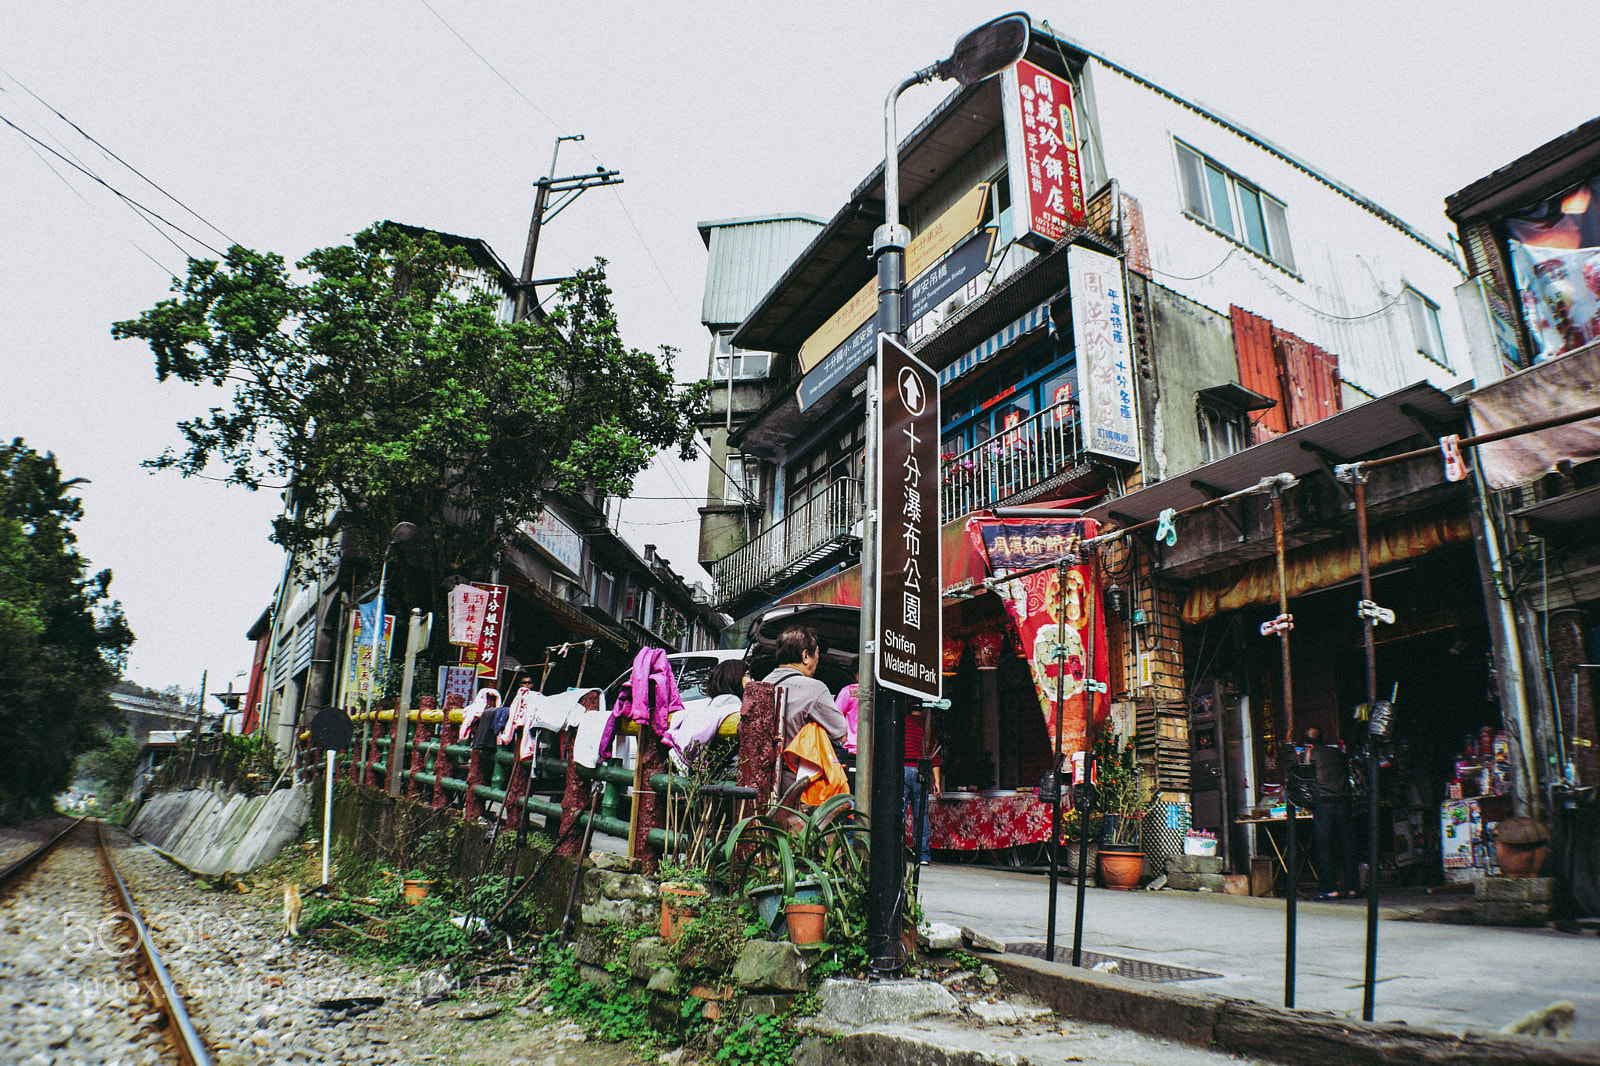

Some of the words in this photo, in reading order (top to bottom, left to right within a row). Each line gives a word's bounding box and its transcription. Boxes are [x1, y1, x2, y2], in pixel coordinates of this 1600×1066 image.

[911, 223, 943, 255] 十分車站
[912, 263, 947, 301] 靜安吊橋
[902, 423, 922, 630] 十分瀑布公園
[481, 587, 503, 663] 十分姐妹快炒
[884, 630, 917, 656] Shifen
[884, 652, 919, 679] Waterfall
[919, 665, 938, 685] Park
